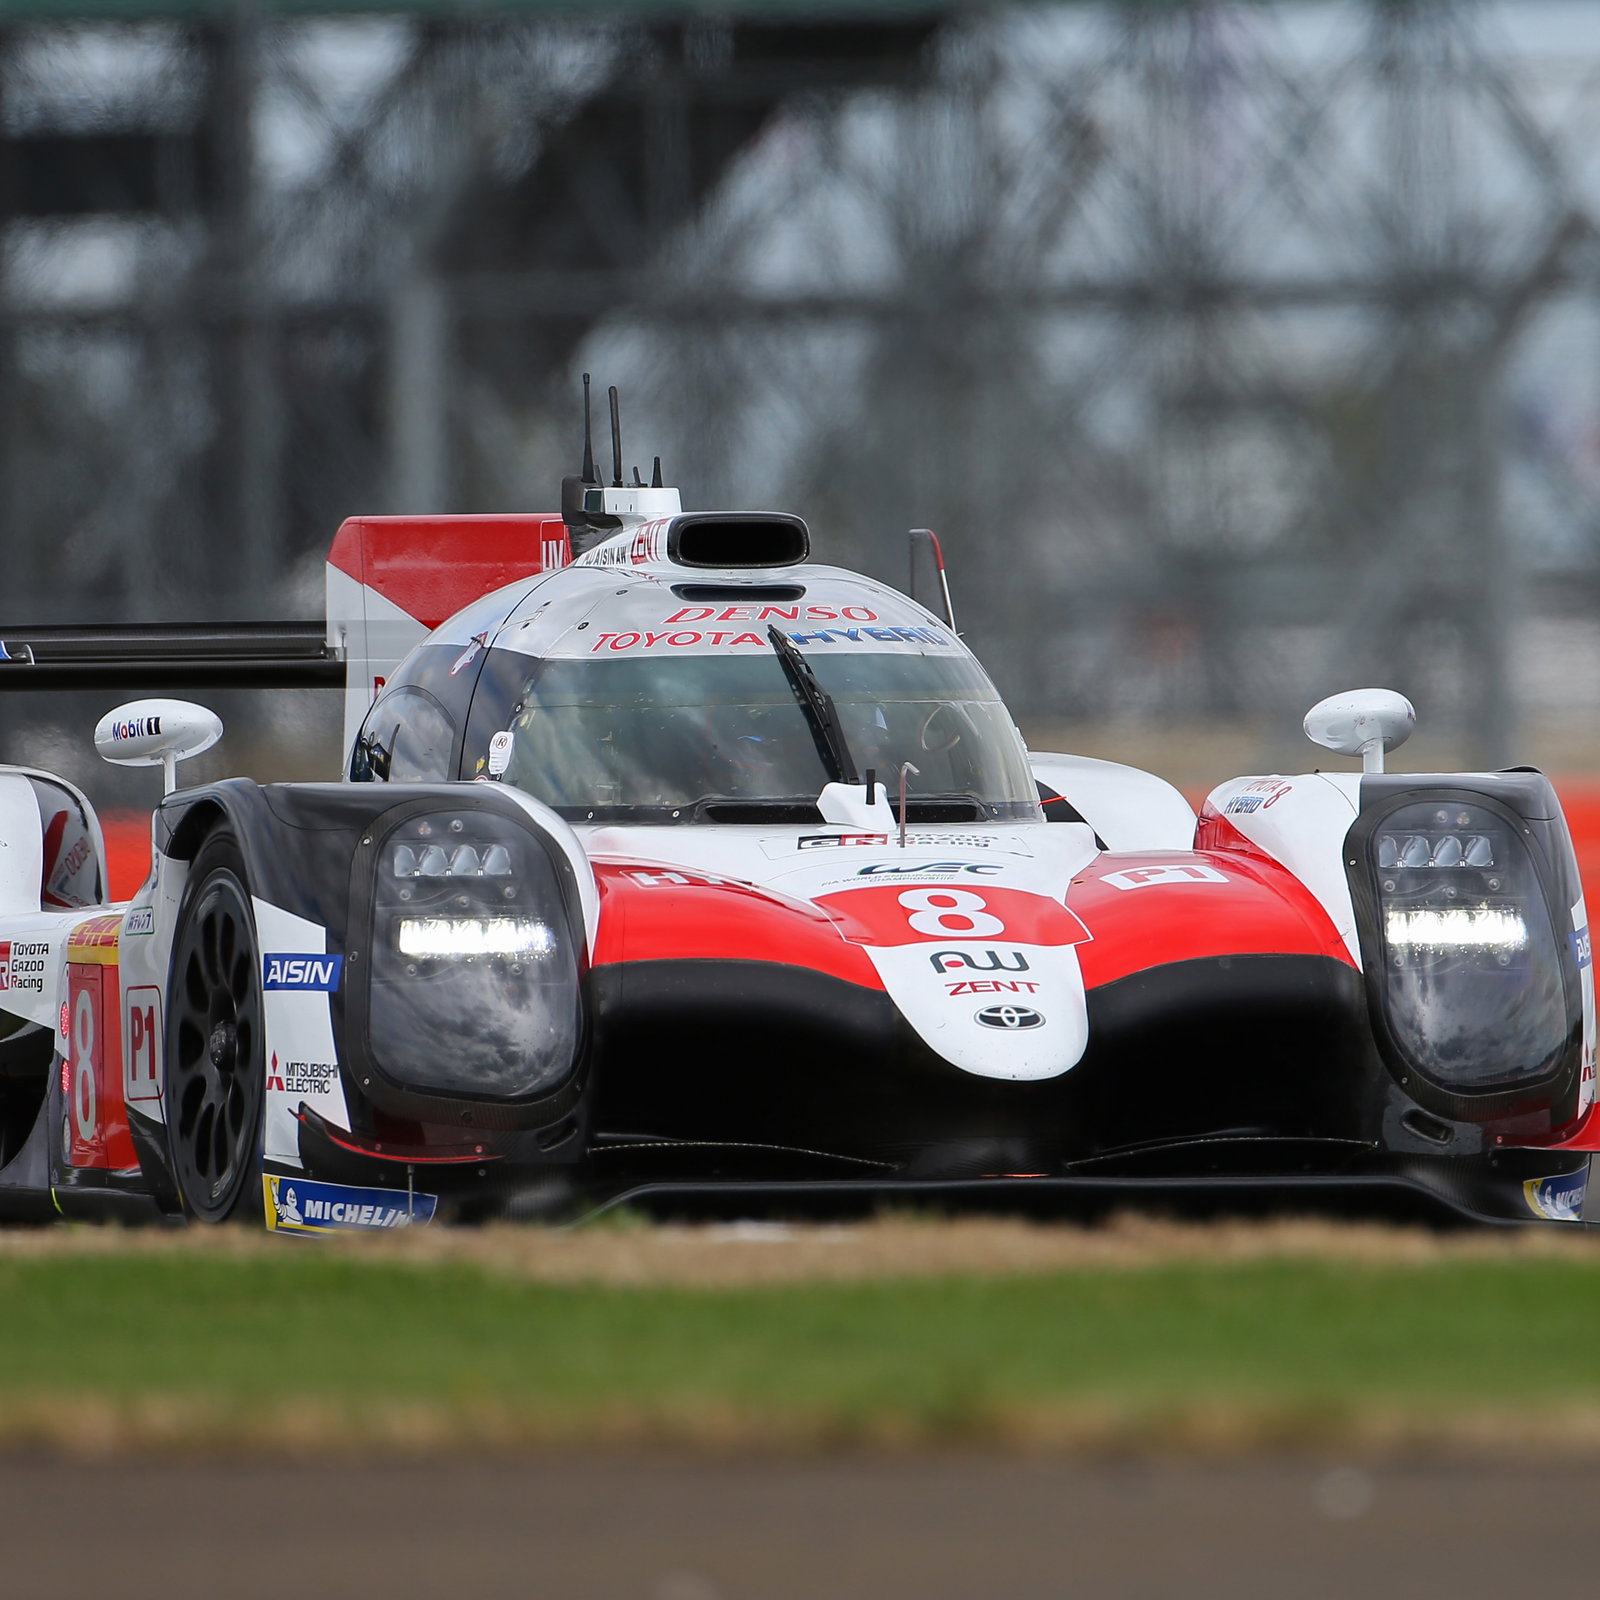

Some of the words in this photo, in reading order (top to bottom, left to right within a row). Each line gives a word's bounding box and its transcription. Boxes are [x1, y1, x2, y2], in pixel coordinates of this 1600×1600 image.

[594, 548, 615, 566] AISIN
[661, 605, 879, 625] DENSO
[590, 631, 769, 653] TOYOTA
[788, 625, 951, 647] HYBRID
[112, 718, 145, 741] Mobil
[147, 716, 161, 736] 1
[1224, 796, 1264, 815] HYBRID
[1263, 786, 1293, 809] 8
[799, 835, 887, 849] GR
[857, 862, 1004, 876] WEC
[1119, 867, 1209, 884] P1
[842, 875, 882, 884] WORLD
[898, 888, 1005, 937] 8
[12, 942, 50, 956] TOYOTA
[11, 959, 45, 972] GAZOO
[265, 960, 335, 984] AISIN
[11, 975, 43, 993] Racing
[944, 981, 1041, 996] ZENT
[131, 1005, 157, 1082] P1
[75, 989, 97, 1142] 8
[285, 1062, 340, 1079] MITSUBISHI
[285, 1077, 331, 1094] ELECTRIC
[304, 1199, 415, 1229] MICHELIN
